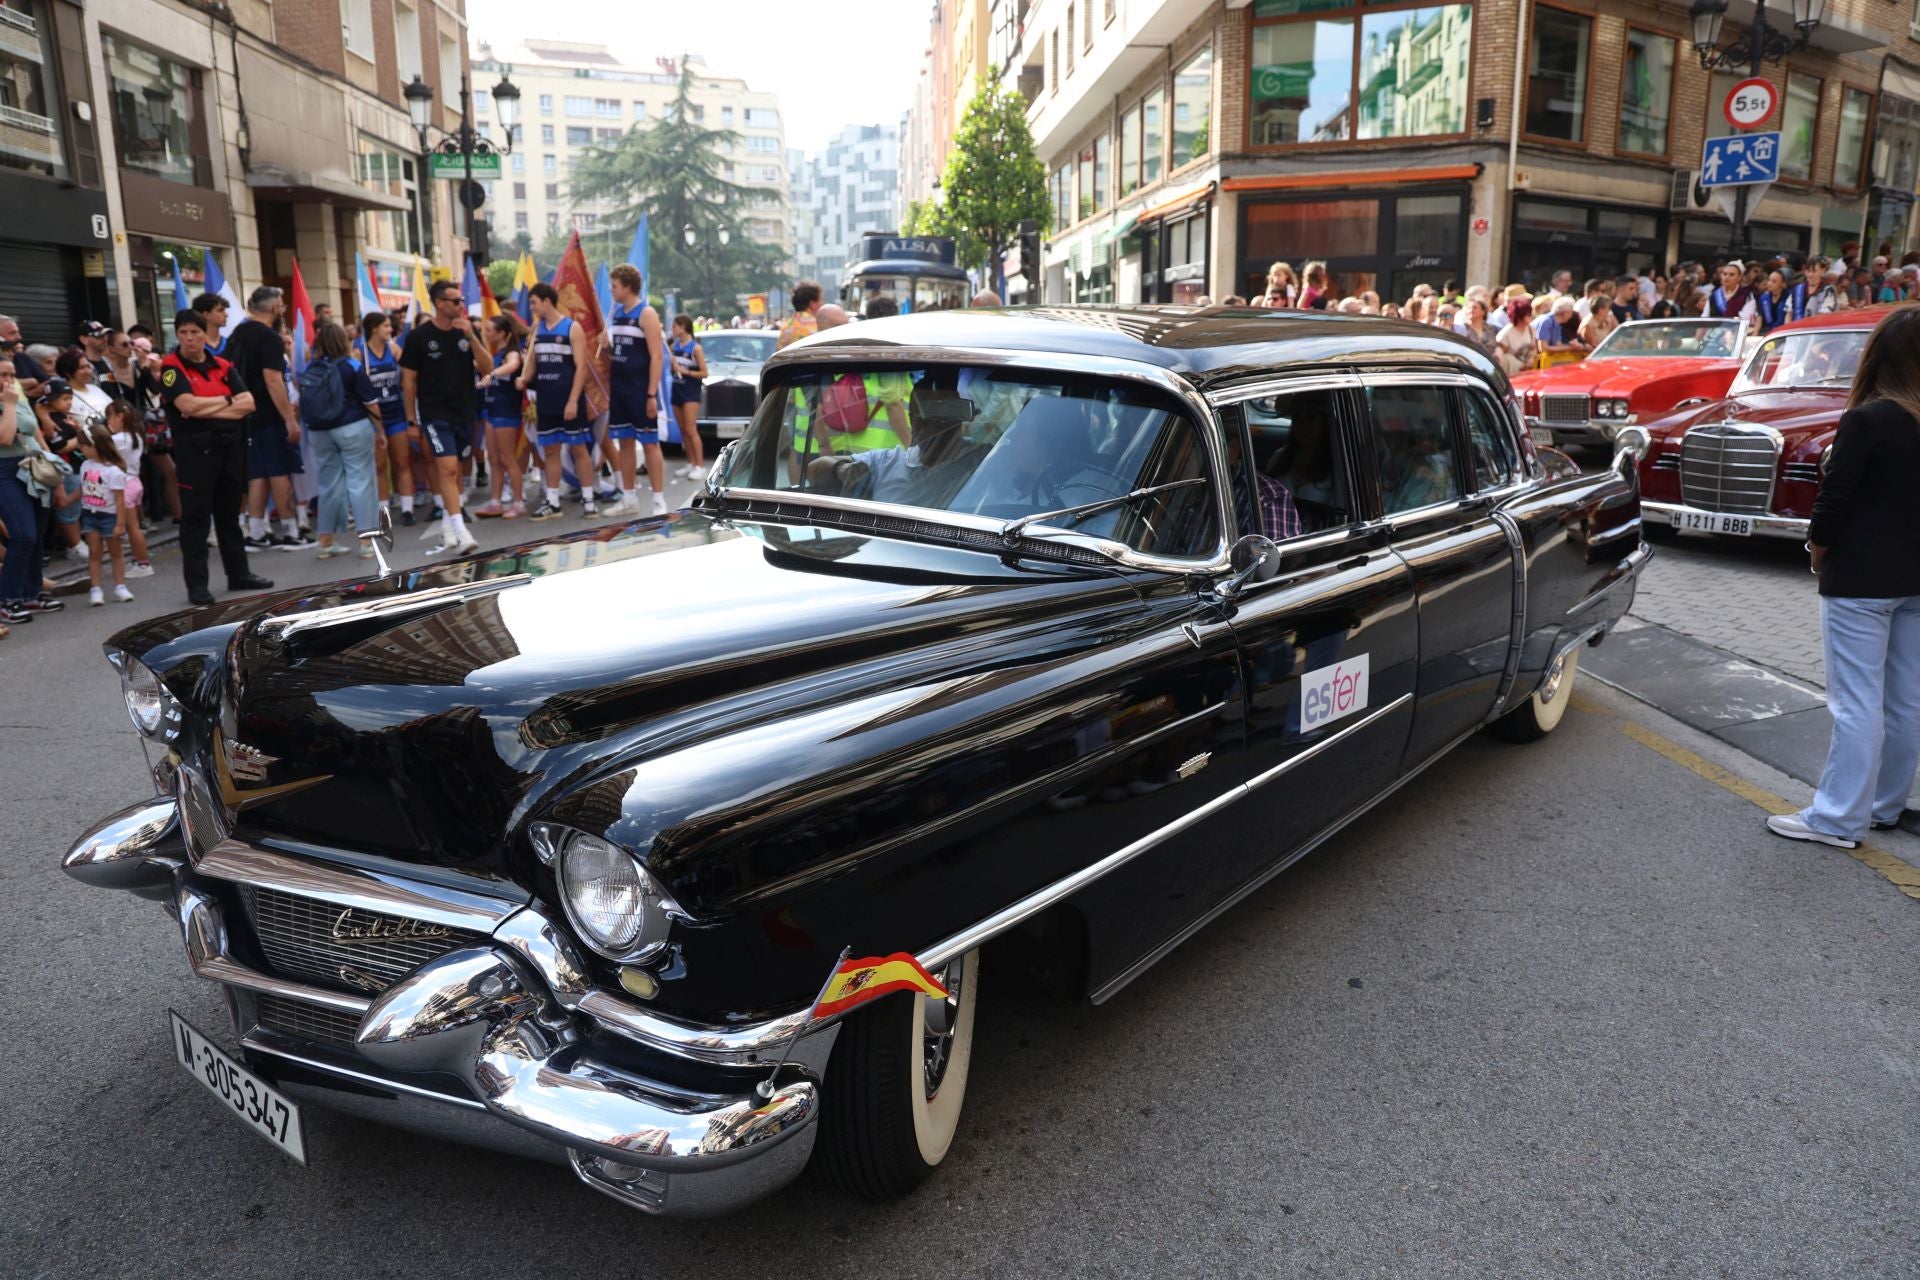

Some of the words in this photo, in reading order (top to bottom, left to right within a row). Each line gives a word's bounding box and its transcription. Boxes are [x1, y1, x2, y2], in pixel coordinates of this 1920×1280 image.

[883, 240, 941, 255] ALSA
[1405, 255, 1441, 269] Anne
[1673, 511, 1682, 526] H
[1687, 513, 1716, 531] 1211
[1722, 517, 1749, 534] BBB
[1304, 666, 1362, 724] esfer
[332, 907, 454, 940] Cadillac
